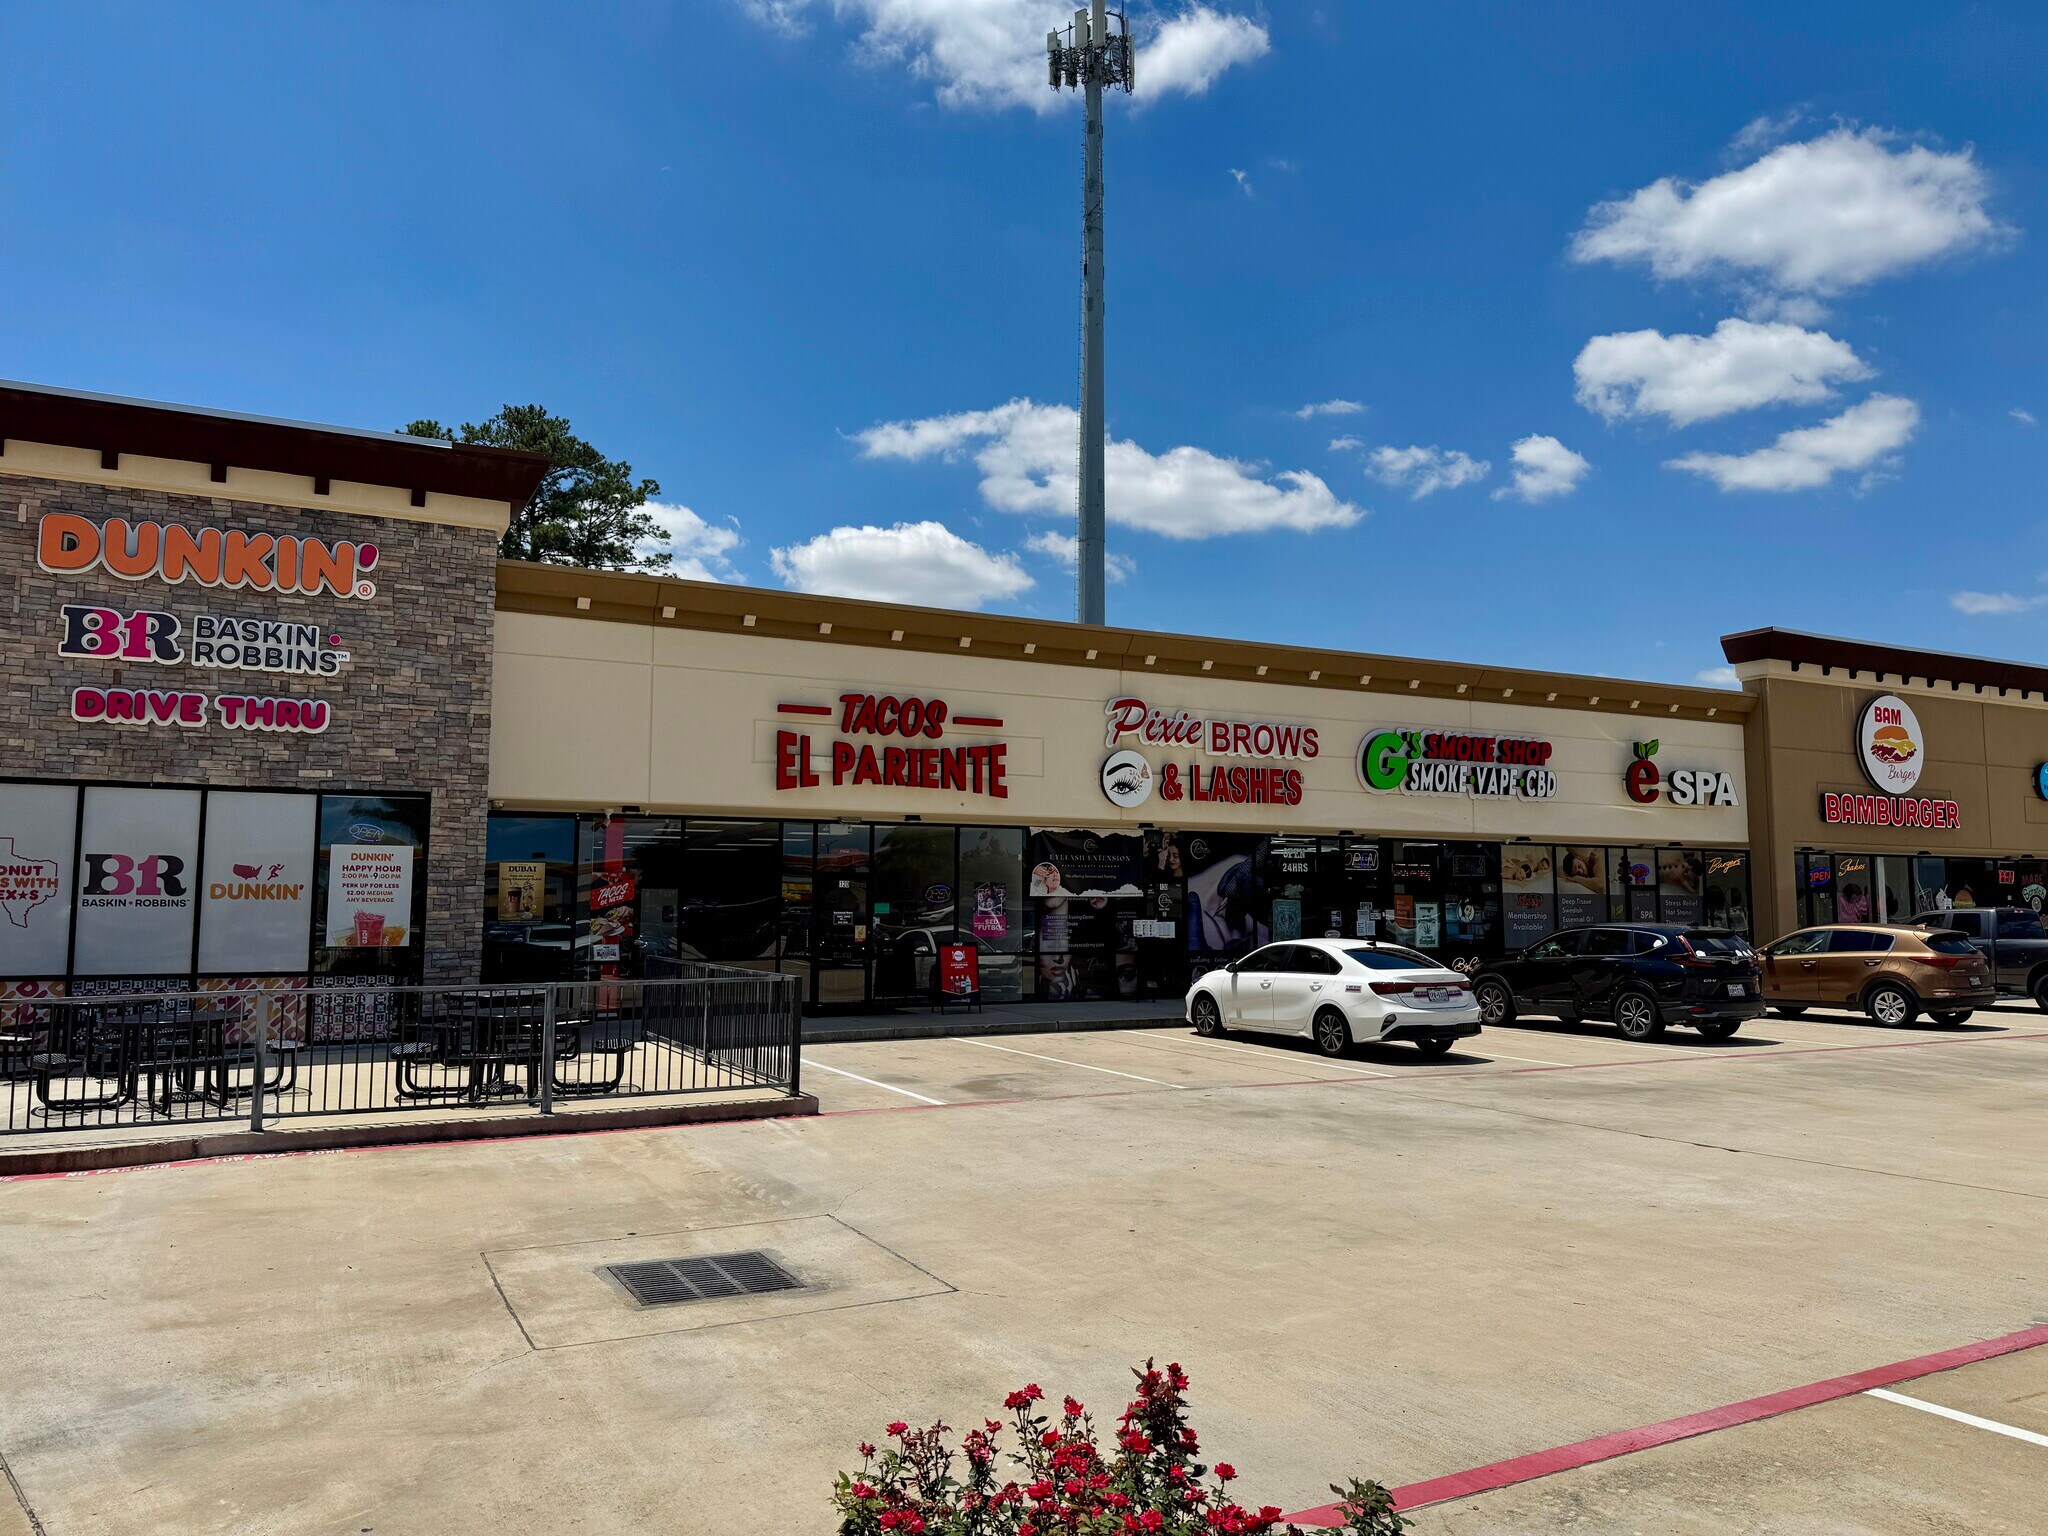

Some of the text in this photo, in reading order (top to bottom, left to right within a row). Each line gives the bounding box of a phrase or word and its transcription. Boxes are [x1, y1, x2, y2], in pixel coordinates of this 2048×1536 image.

[39, 513, 379, 597] DUNKIN'
[194, 617, 319, 647] BASKIN
[194, 642, 340, 673] ROBBINS
[72, 688, 330, 732] DRIVE THRU
[840, 693, 948, 738] TACOS
[1874, 706, 1901, 725] BAM
[1109, 698, 1319, 758] Pixie BROWS
[1427, 734, 1552, 766] SMOKE SHOP
[777, 730, 1008, 798] EL PARIENTE
[1888, 764, 1917, 783] Burger
[1163, 763, 1303, 805] & LASHES
[1410, 763, 1557, 797] SMOKE VAPE CBD
[1672, 770, 1740, 806] SPA
[1825, 793, 1960, 829] BAMBURGER
[349, 826, 384, 839] OPEN
[351, 853, 394, 861] DUNKIN'
[1087, 854, 1131, 862] EXTENSION
[1283, 848, 1306, 859] OPEN
[1344, 852, 1377, 867] OPEN
[83, 853, 187, 897] BR
[1282, 863, 1308, 872] 24HRS
[1837, 858, 1866, 877] Shakes
[14, 878, 59, 888] WITH
[2021, 873, 2044, 886] MADE
[209, 883, 305, 900] DUNKIN'
[597, 882, 629, 901] TACOS
[82, 899, 187, 908] BASKIN ROBBINS
[1507, 911, 1548, 921] Membership
[1640, 911, 1654, 919] SPA
[1512, 923, 1544, 931] Available
